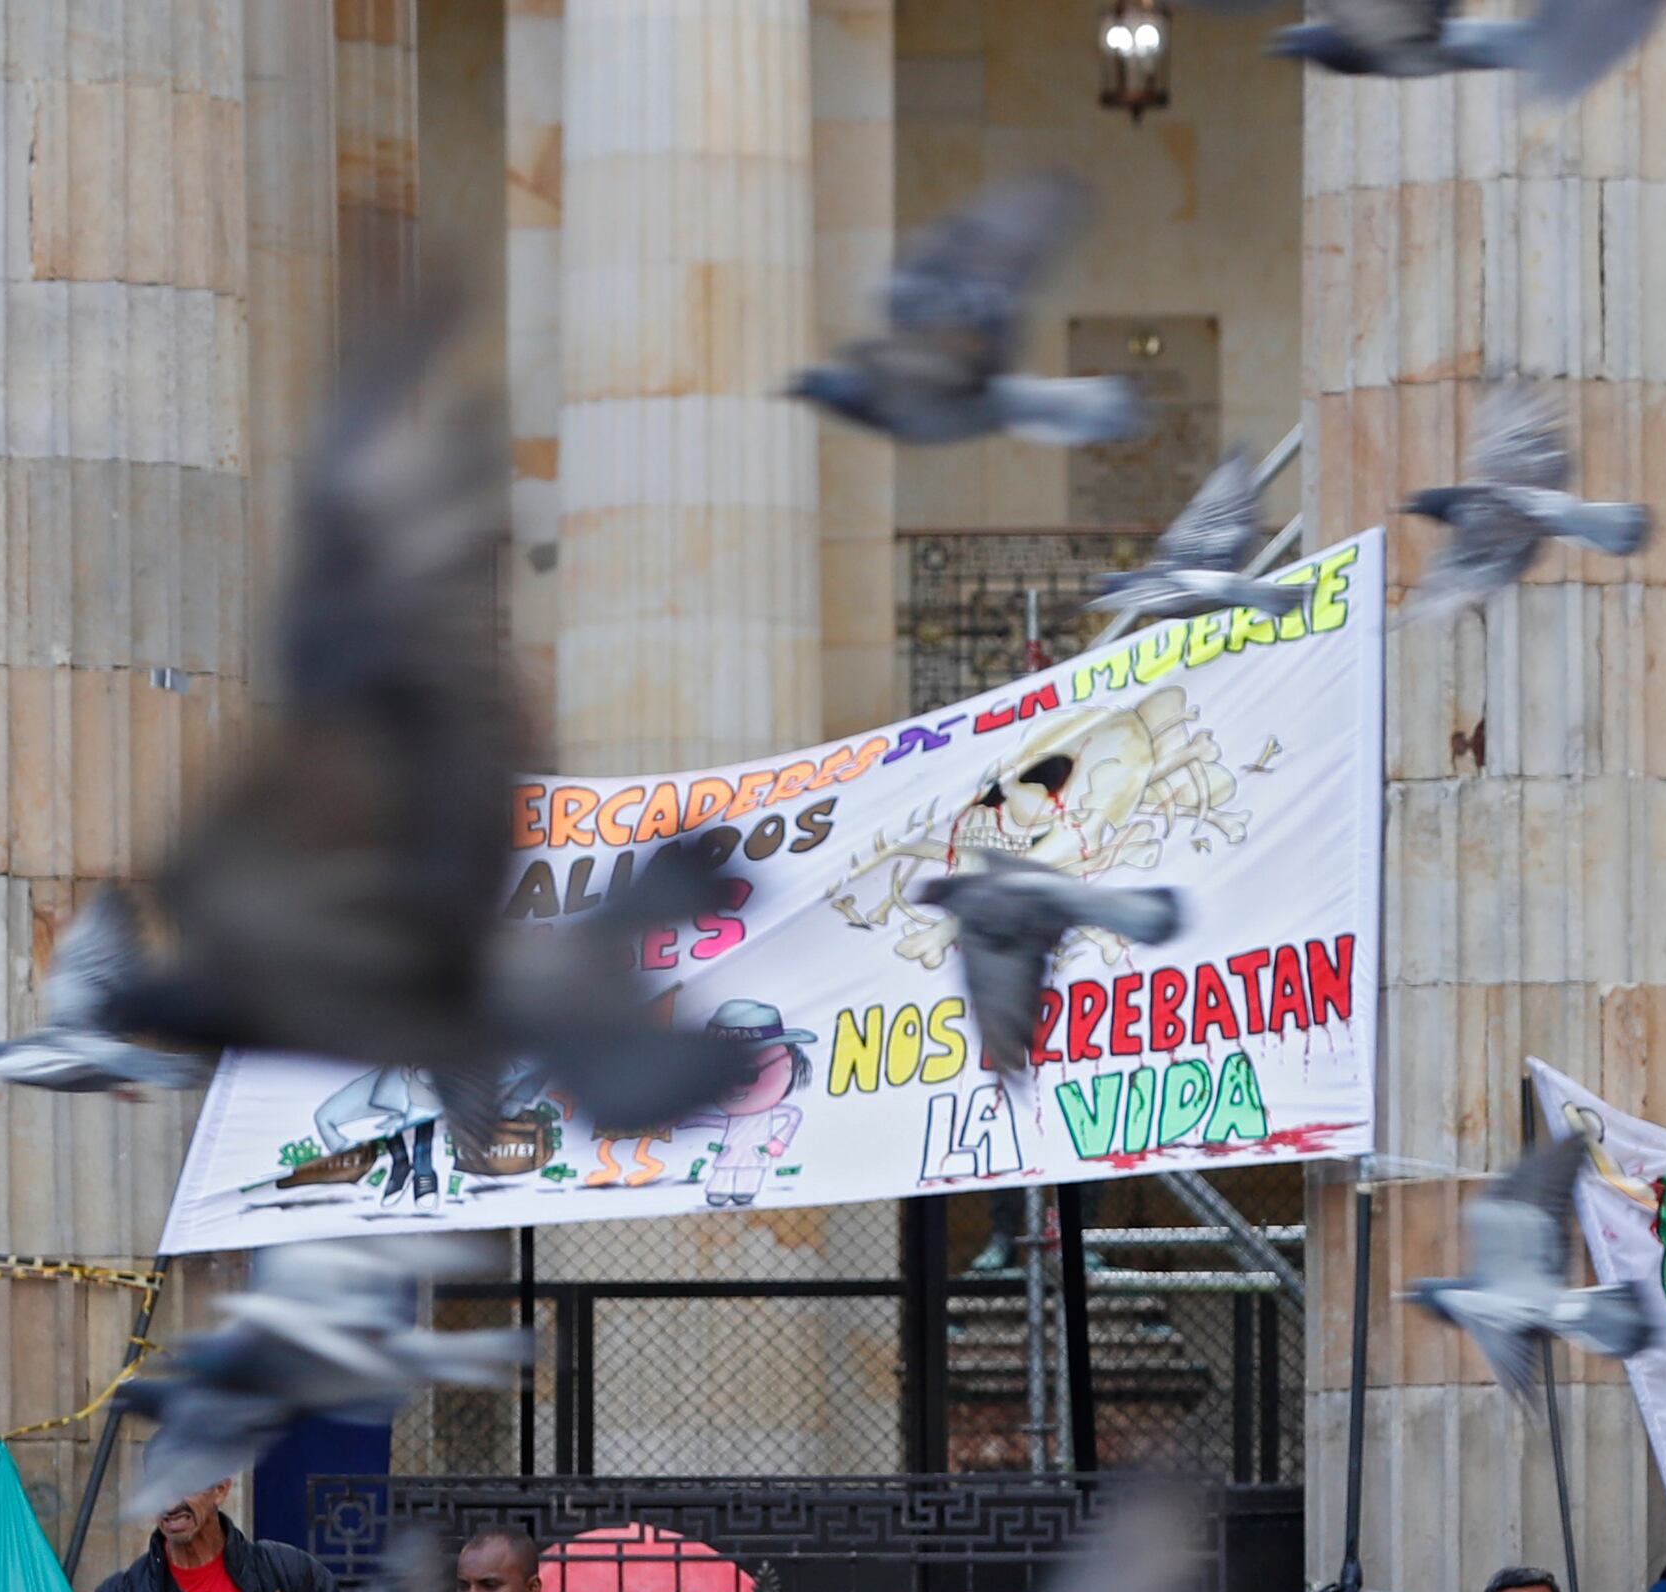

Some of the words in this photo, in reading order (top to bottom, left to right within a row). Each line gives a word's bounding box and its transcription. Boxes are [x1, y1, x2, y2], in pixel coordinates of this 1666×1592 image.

[511, 736, 890, 849] ERCADERES
[501, 797, 837, 919] ALIDOS
[828, 997, 967, 1096] NOS
[981, 934, 1355, 1070] RREBATAN
[919, 1084, 1023, 1182] LA
[1056, 1053, 1267, 1160] VIDA
